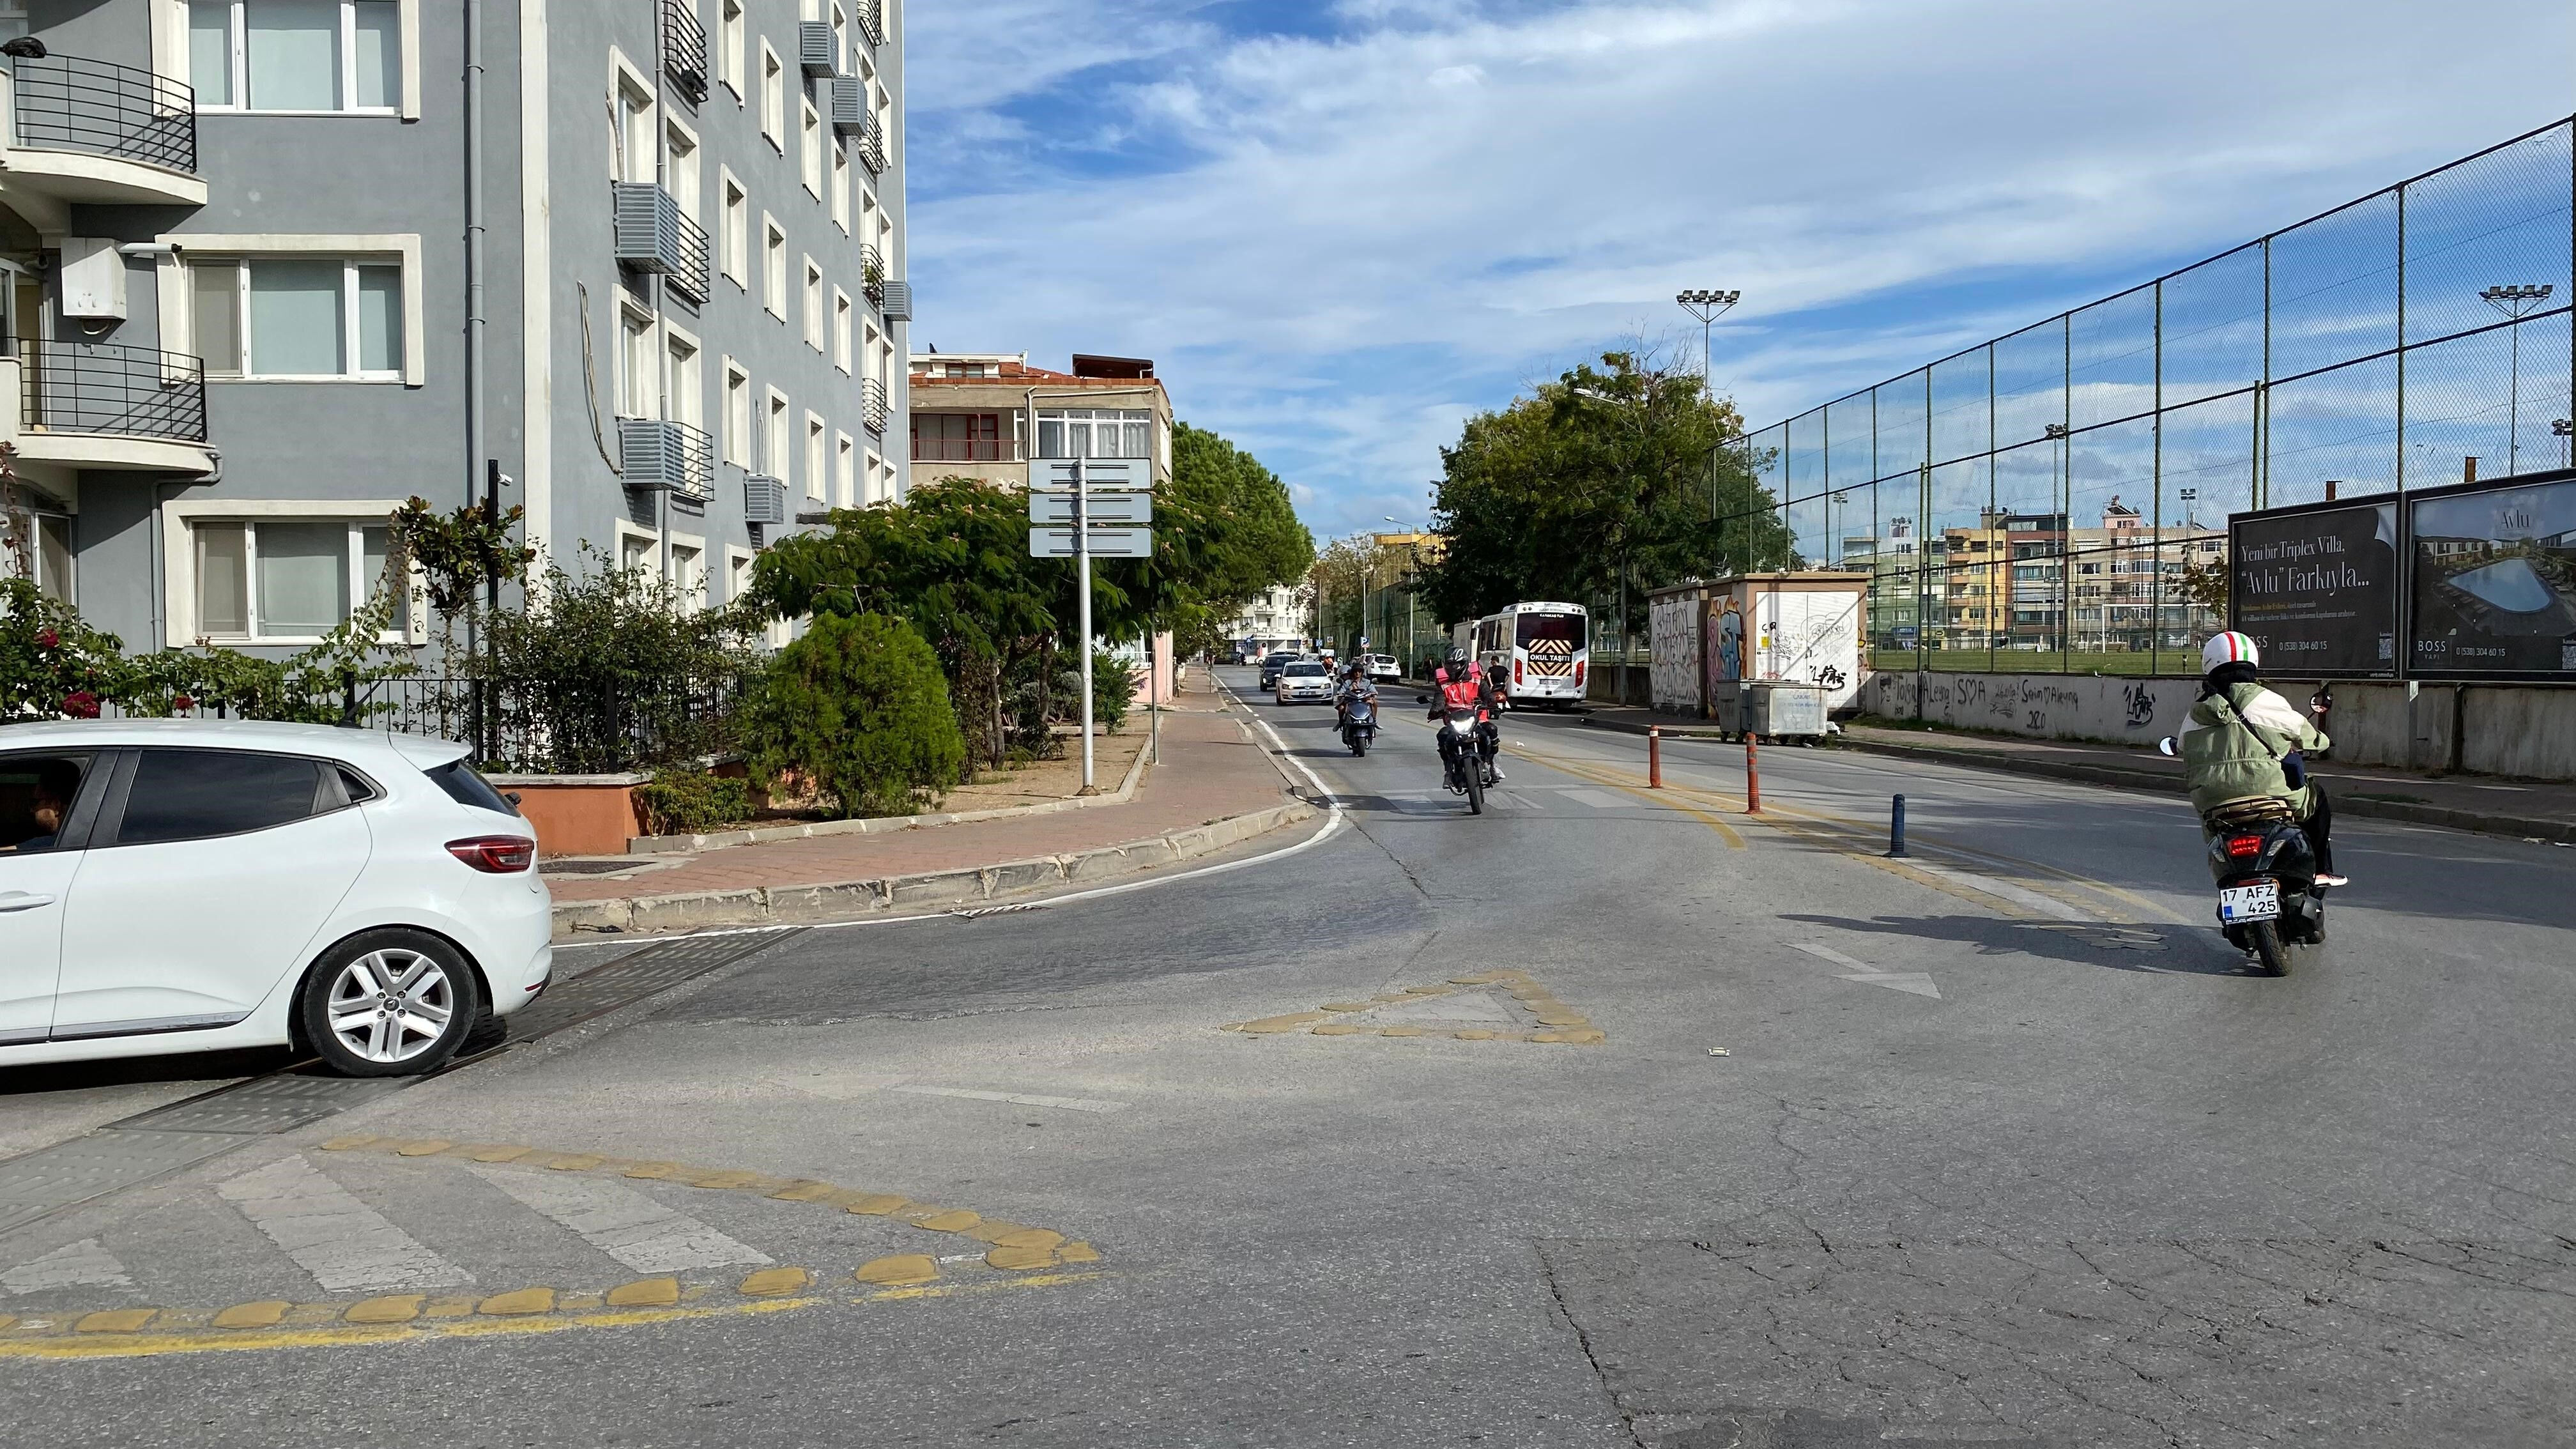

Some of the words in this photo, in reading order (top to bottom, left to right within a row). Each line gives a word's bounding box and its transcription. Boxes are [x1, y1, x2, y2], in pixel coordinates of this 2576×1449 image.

[2501, 509, 2529, 528] Avlu
[2242, 545, 2263, 562] Yeni
[2265, 544, 2278, 559] bir
[2280, 540, 2315, 562] Triplex
[2288, 562, 2369, 596] Farkıyla...
[1361, 637, 1367, 647] P
[2279, 642, 2283, 650] 0
[2284, 641, 2297, 651] (538)
[2299, 641, 2310, 650] 304
[2311, 641, 2319, 650] 60
[2320, 641, 2327, 650] 15
[2418, 641, 2446, 652] BOSS
[2456, 647, 2460, 656] 0
[2461, 647, 2475, 657] (538)
[2476, 648, 2487, 656] 304
[2488, 648, 2497, 656] 60
[2223, 889, 2237, 901] 17
[2246, 885, 2275, 899] AFZ
[2248, 900, 2276, 914] 425
[187, 1014, 231, 1023] CLIO
